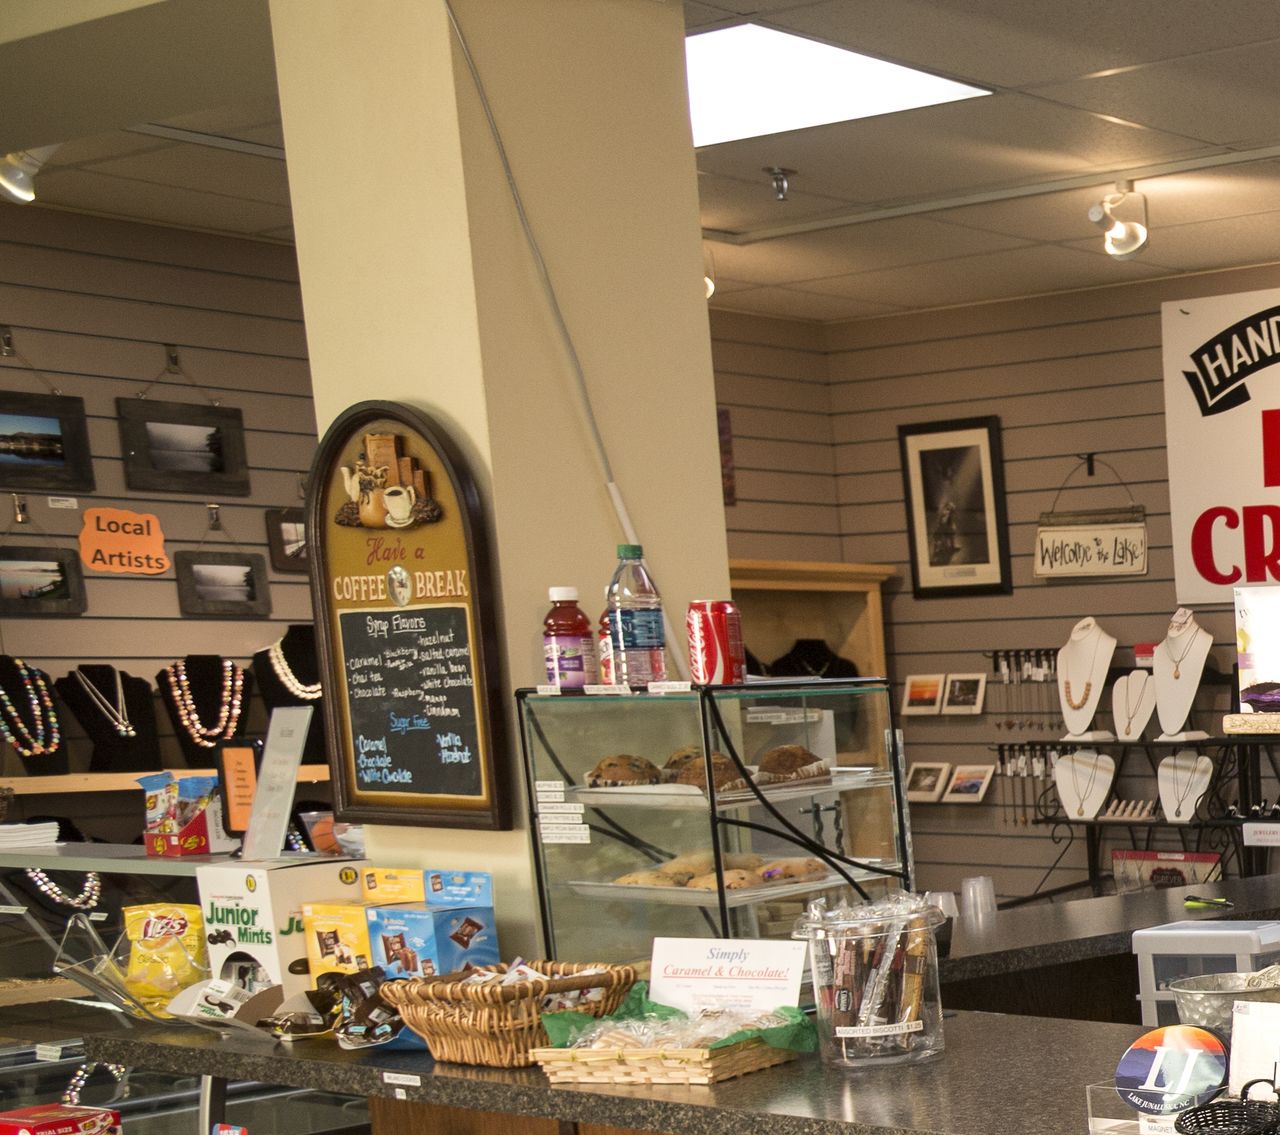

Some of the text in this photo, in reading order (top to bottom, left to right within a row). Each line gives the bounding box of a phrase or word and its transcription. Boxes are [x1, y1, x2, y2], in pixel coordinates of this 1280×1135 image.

[95, 516, 152, 537] Local
[91, 549, 166, 570] Artists
[367, 537, 425, 565] Have a
[1040, 536, 1144, 569] Welcome Lake!
[334, 570, 468, 601] COFFEE BREAK
[206, 903, 258, 926] Junior
[238, 927, 272, 944] Mints
[707, 948, 750, 963] Simply
[663, 965, 790, 978] Caramel & Chocolate!
[58, 1126, 73, 1134] SIZE
